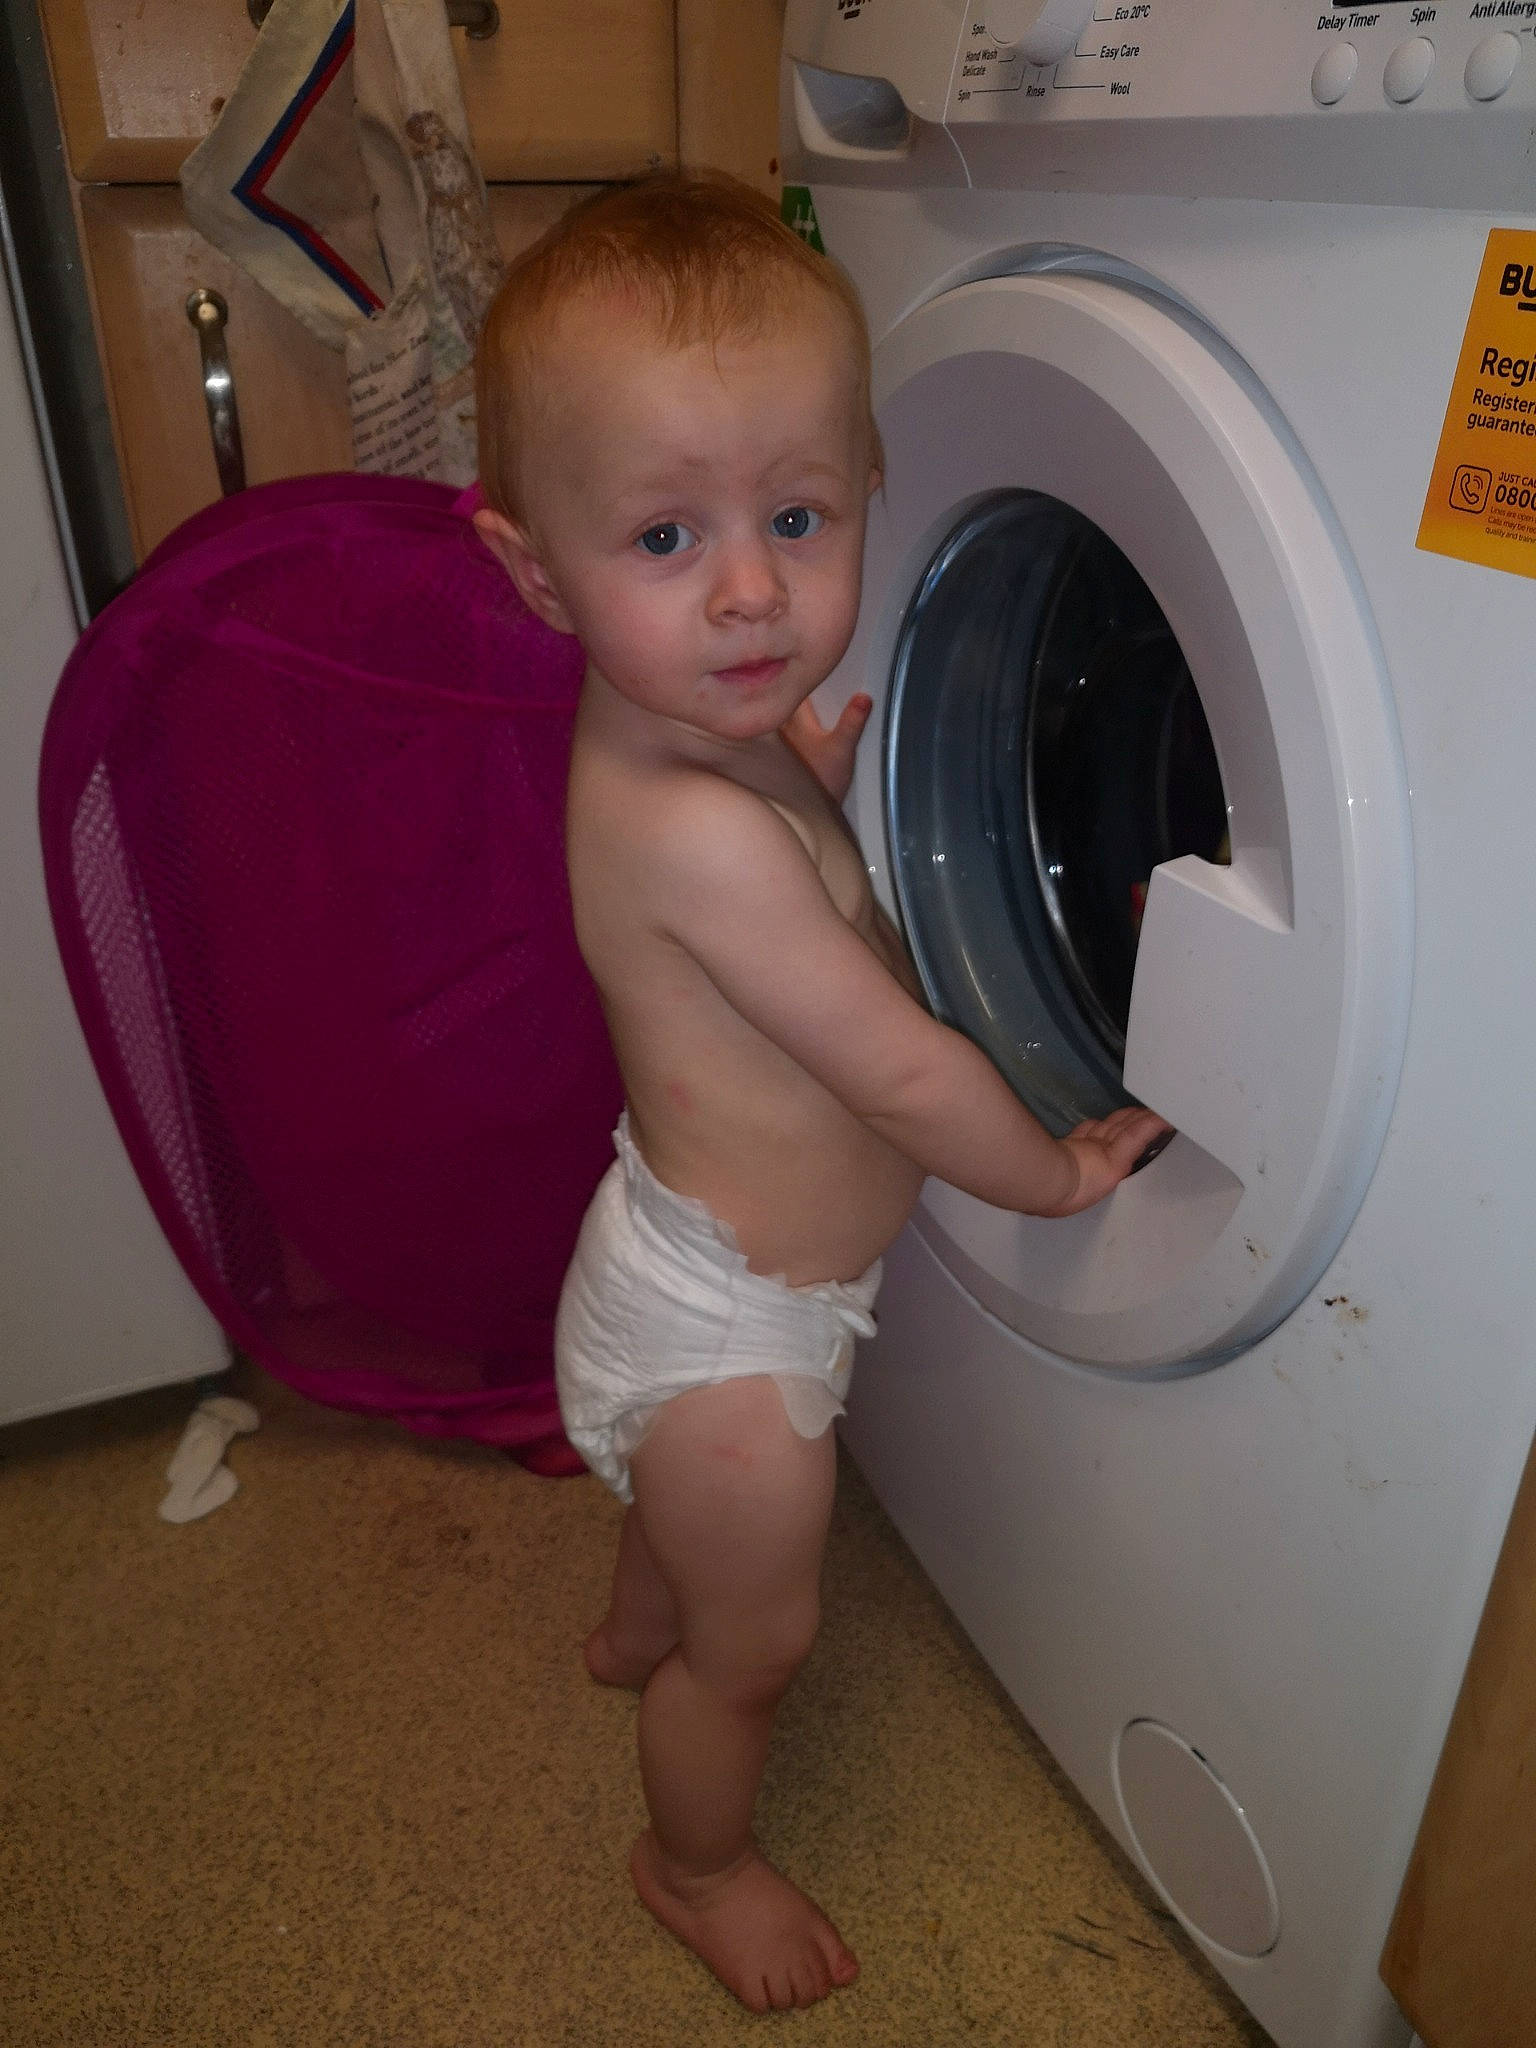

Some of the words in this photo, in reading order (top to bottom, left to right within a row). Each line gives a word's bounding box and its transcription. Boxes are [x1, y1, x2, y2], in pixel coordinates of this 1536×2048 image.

[1114, 7, 1129, 20] Eco
[1410, 7, 1438, 26] Spin
[1469, 1, 1497, 18] Anti
[1495, 0, 1536, 19] Allerg
[1317, 15, 1347, 31] Delay
[1348, 13, 1381, 28] Timer
[965, 50, 981, 62] Hand
[981, 48, 998, 60] Wash
[1100, 45, 1119, 60] Easy
[1120, 44, 1140, 57] Care
[957, 89, 971, 103] Spin
[1025, 85, 1046, 97] Rinse
[1110, 82, 1131, 95] Wool
[1480, 347, 1536, 388] Regi
[1472, 387, 1536, 415] Register
[1466, 413, 1536, 437] guarante
[1498, 471, 1520, 484] JUST
